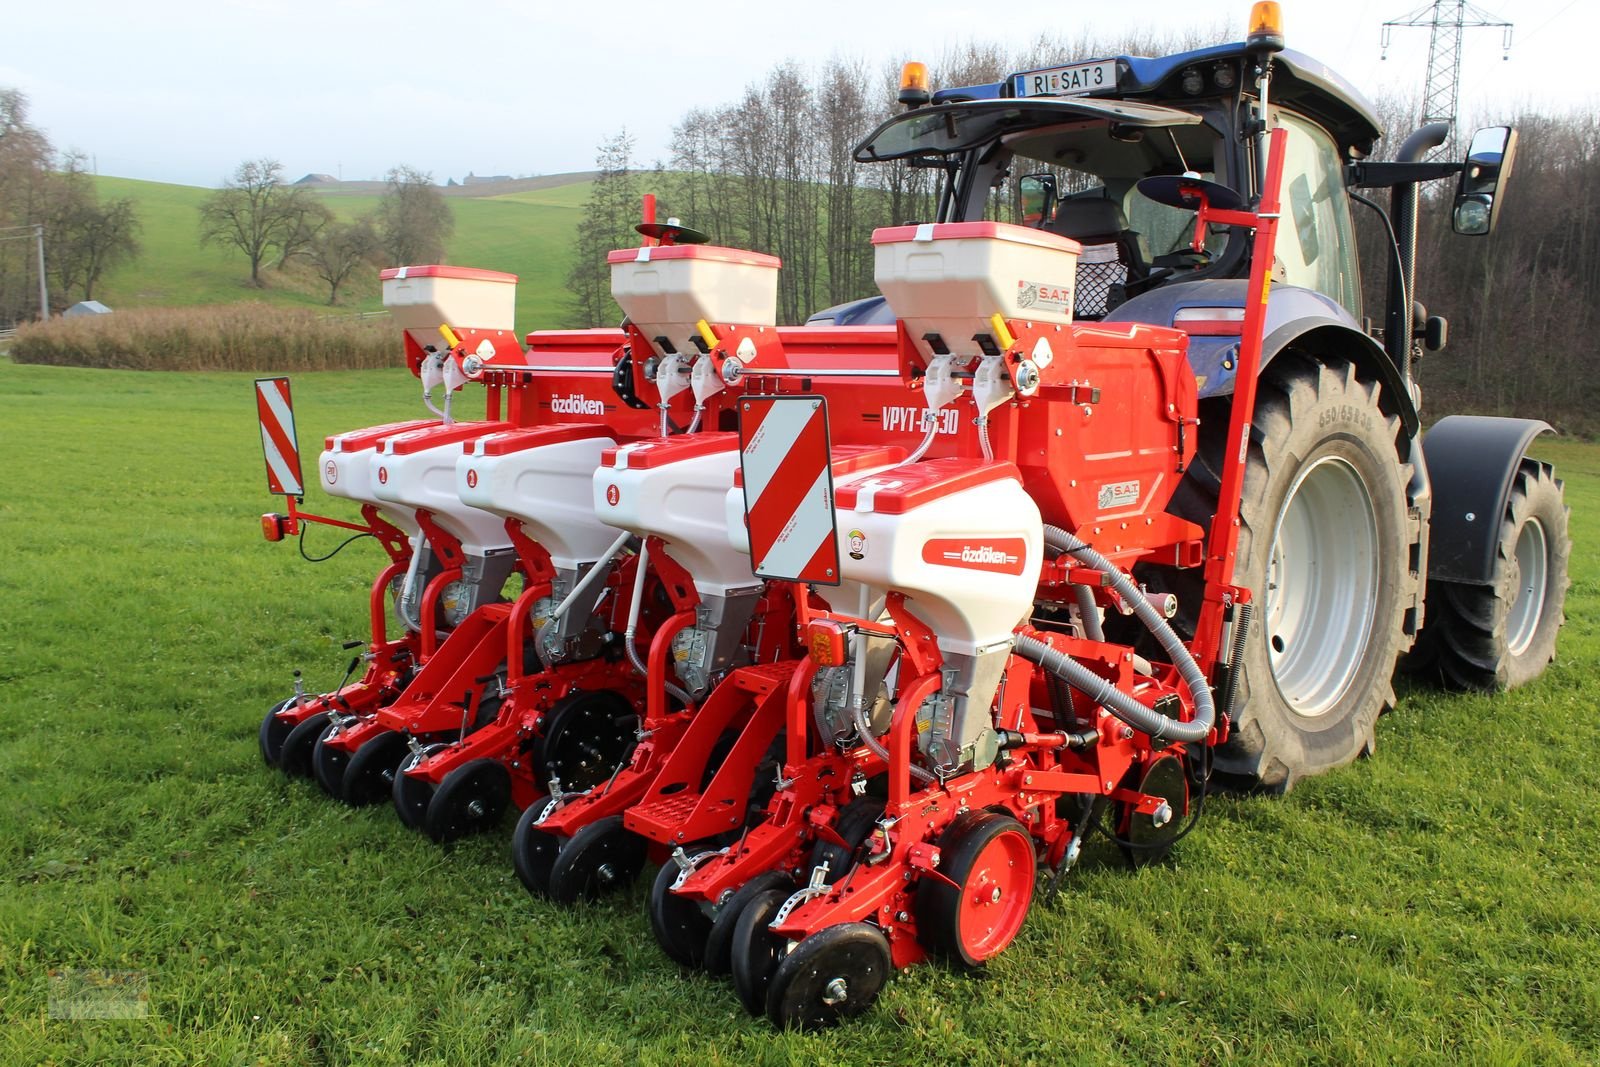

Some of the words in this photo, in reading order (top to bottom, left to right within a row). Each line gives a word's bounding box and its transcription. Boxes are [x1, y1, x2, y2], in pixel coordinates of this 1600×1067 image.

[1034, 75, 1048, 93] RI
[1061, 68, 1090, 90] SAT
[1094, 66, 1103, 85] 3
[551, 393, 604, 415] özdöken
[962, 546, 1007, 564] özdöken
